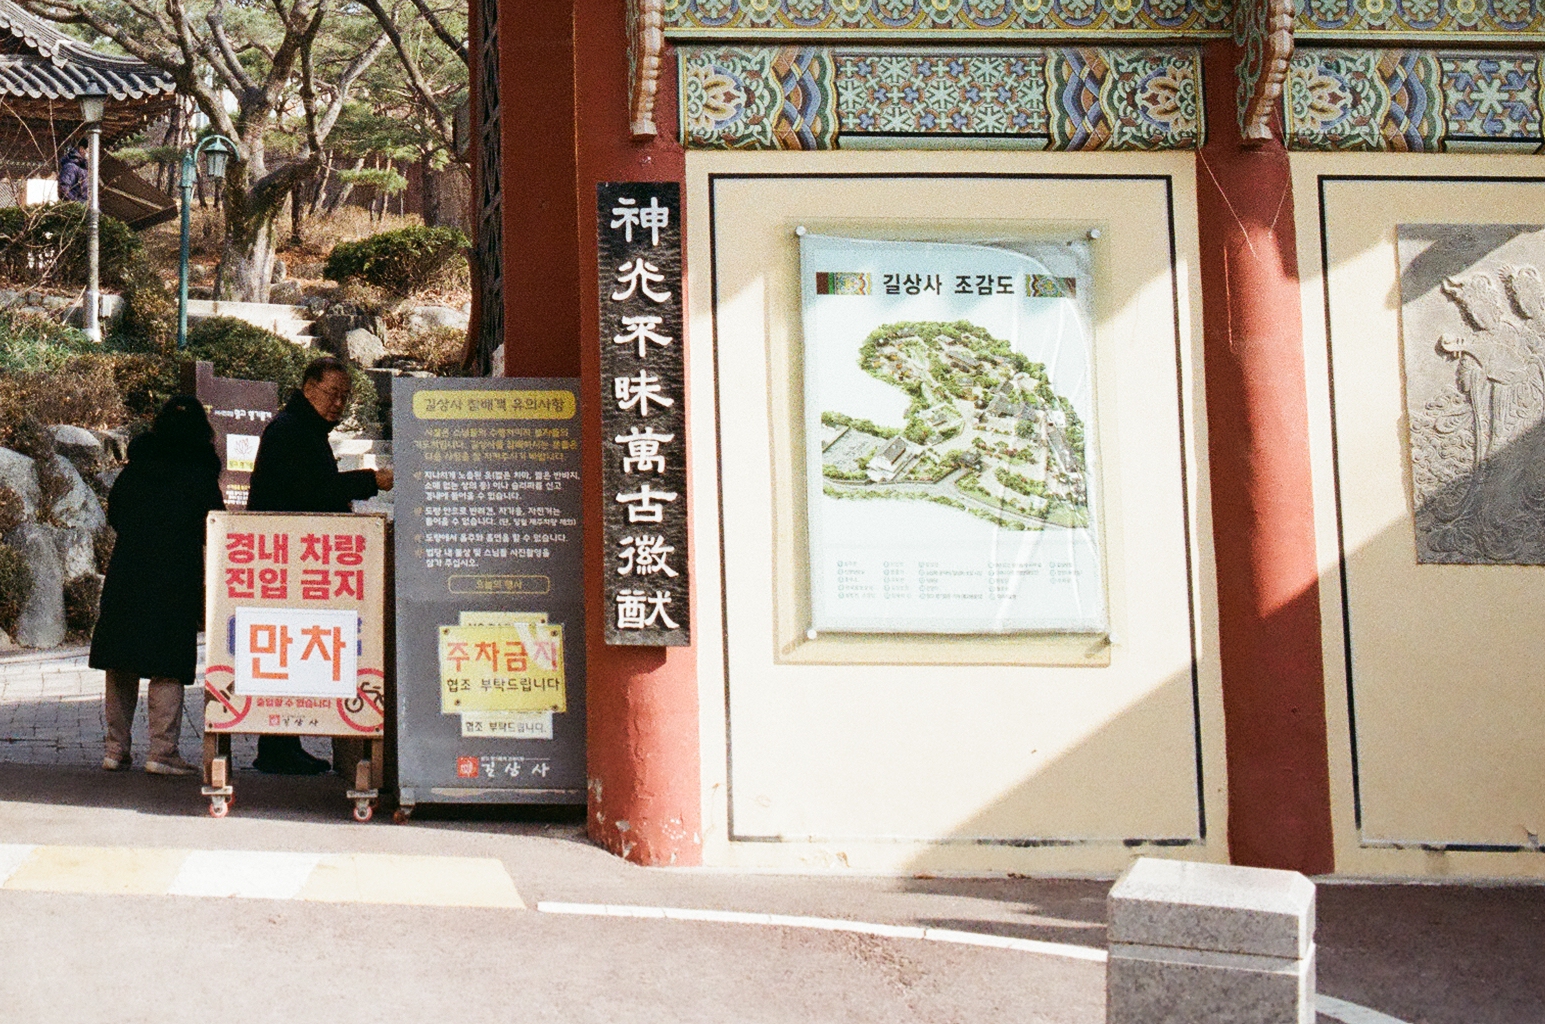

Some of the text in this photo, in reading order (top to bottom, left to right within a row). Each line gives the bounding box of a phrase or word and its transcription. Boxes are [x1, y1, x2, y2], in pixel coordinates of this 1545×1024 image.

[882, 273, 1015, 296] 길상사 조감도
[424, 398, 463, 412] 길상사
[512, 398, 565, 412] 유의사항
[424, 470, 456, 480] 지나치게
[545, 481, 562, 491] 신고
[225, 532, 366, 566] 경내 차량
[224, 567, 364, 601] 진입 금지
[249, 624, 346, 682] 만차
[446, 641, 558, 673] 주차금지
[447, 678, 560, 693] 협조 부탁드립니다
[285, 698, 294, 707] 수
[465, 721, 484, 733] 협조
[481, 761, 550, 778] 길상사
